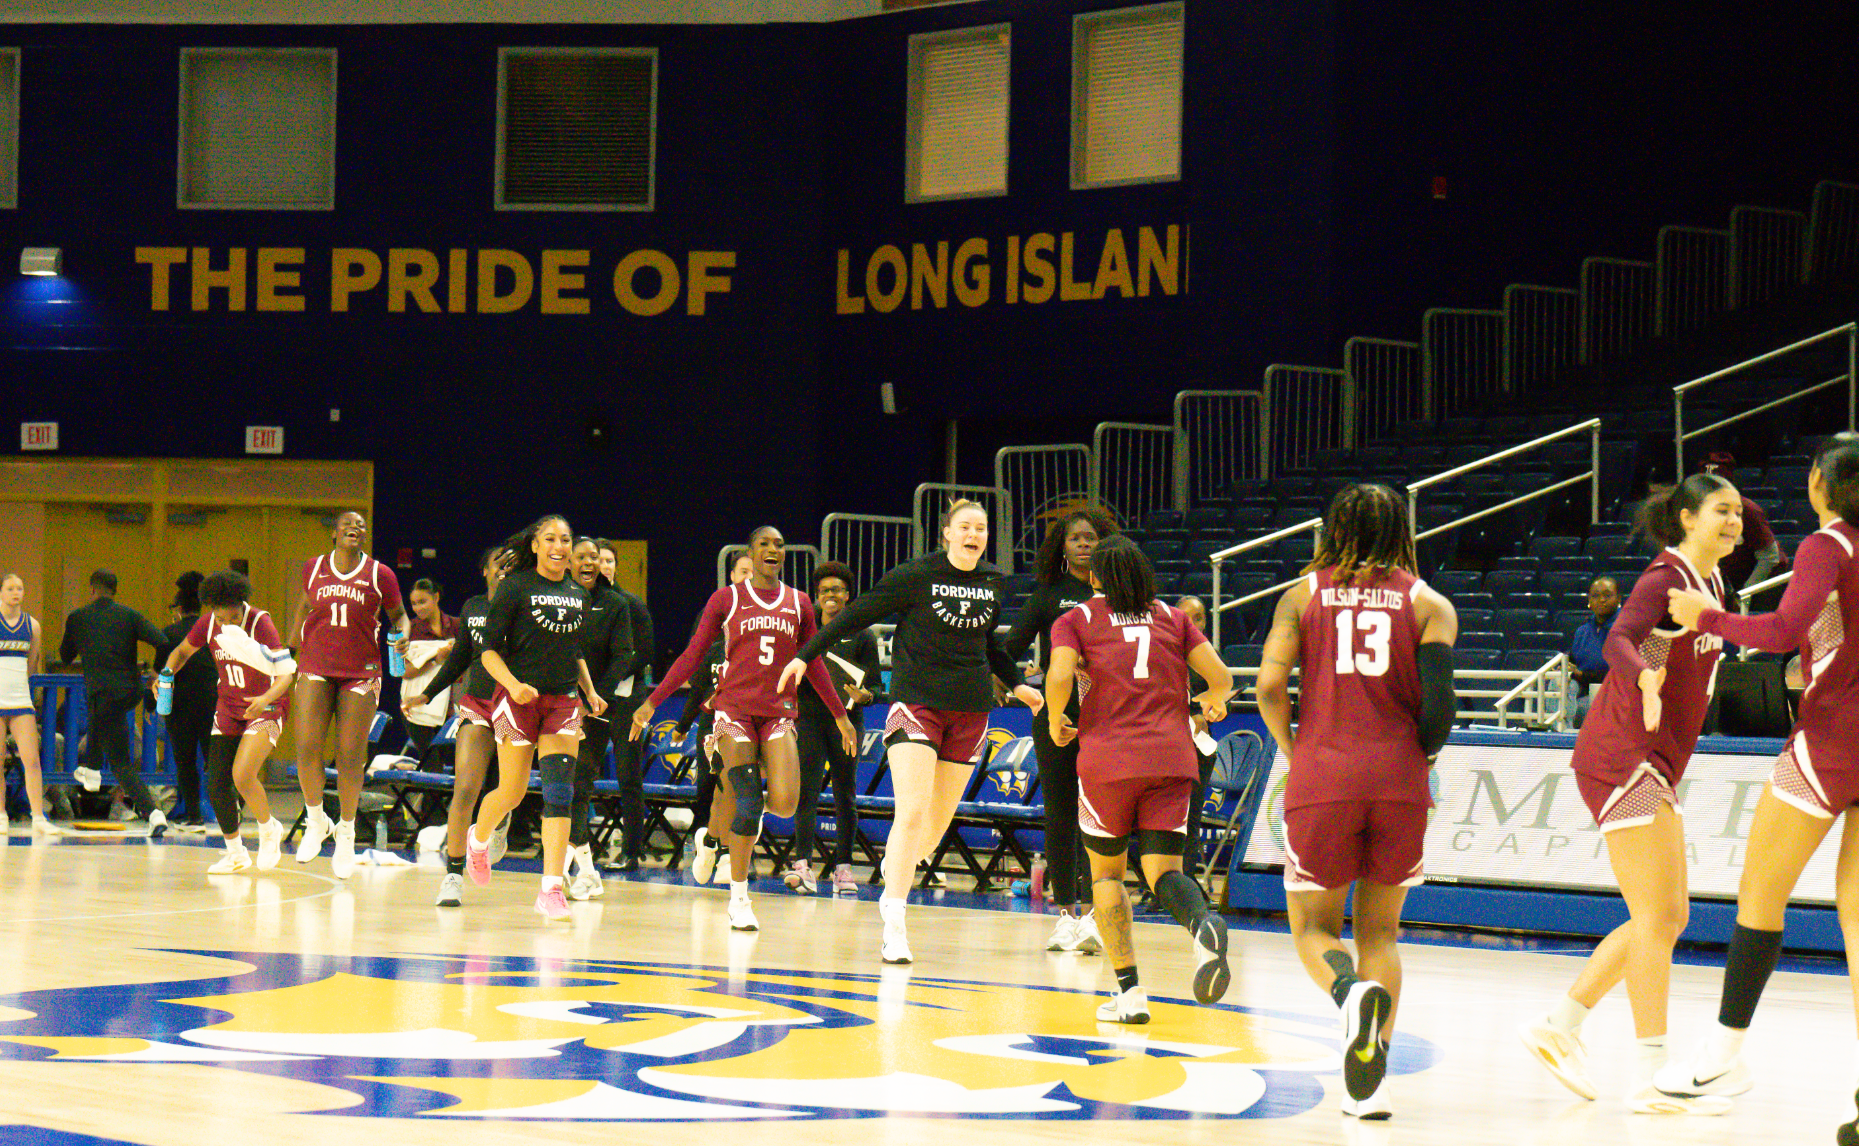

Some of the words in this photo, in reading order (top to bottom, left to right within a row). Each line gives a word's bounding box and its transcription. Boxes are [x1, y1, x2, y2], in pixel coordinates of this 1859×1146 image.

[836, 236, 991, 315] LONG
[1005, 223, 1190, 304] ISLAN
[134, 247, 306, 311] THE
[330, 248, 591, 315] PRIDE
[613, 249, 737, 316] OF
[28, 427, 51, 444] EXIT
[253, 430, 276, 448] EXIT
[316, 585, 365, 605] FORDHAM
[530, 594, 583, 610] FORDHAM
[931, 583, 995, 601] FORDHAM
[1320, 587, 1404, 610] WILSON-SALTOS
[330, 602, 348, 627] 11
[557, 608, 568, 621] F
[931, 600, 993, 628] BASKETBALL
[960, 601, 971, 615] F
[740, 615, 795, 638] FORDHAM
[758, 635, 776, 666] 5
[1122, 626, 1151, 679] 7
[1335, 608, 1392, 677] 13
[225, 663, 246, 689] 10
[820, 822, 837, 831] PRID
